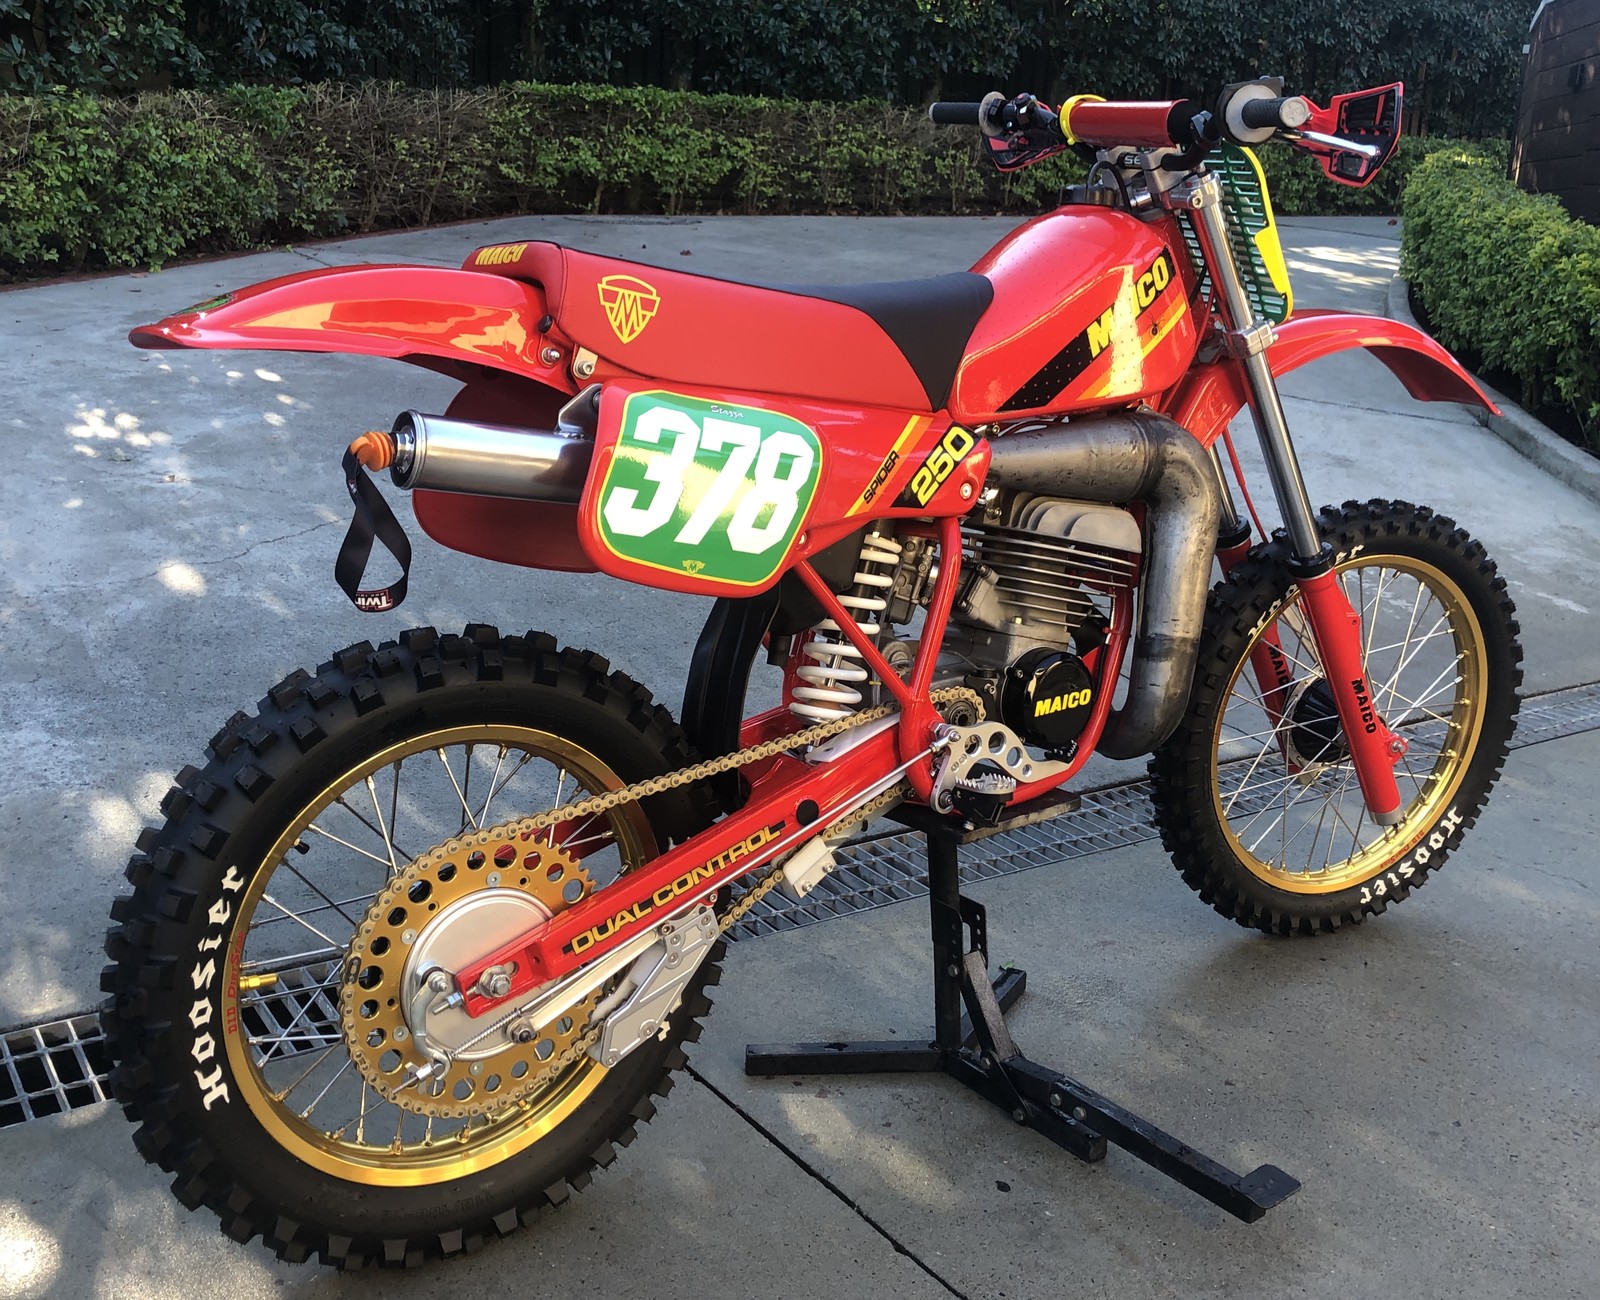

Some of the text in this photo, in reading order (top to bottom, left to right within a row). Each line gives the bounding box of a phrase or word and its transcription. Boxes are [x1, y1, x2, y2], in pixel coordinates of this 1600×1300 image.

[475, 244, 528, 266] MAICO
[1086, 256, 1170, 359] MICO
[603, 406, 815, 555] 378
[863, 450, 900, 504] SPIDER
[911, 426, 974, 507] 250
[1034, 688, 1092, 718] MAICO
[1351, 678, 1377, 734] MAICO
[571, 825, 782, 956] DUAL CONTROL
[1360, 806, 1464, 904] Hoosier
[188, 864, 246, 1112] Hoosier
[226, 1006, 238, 1035] DID
